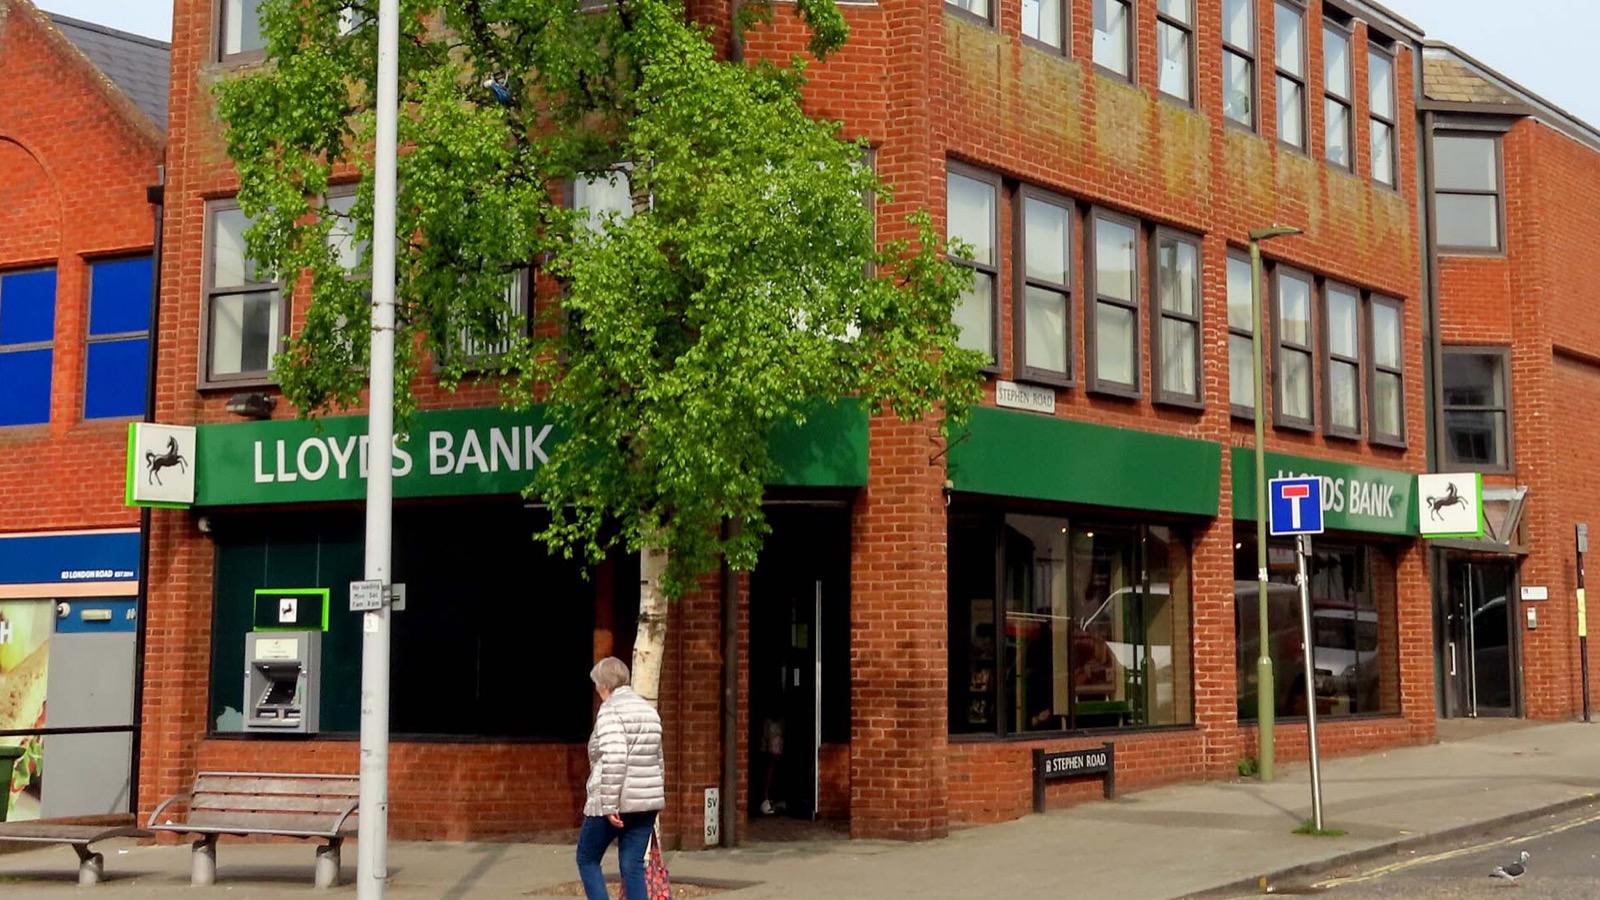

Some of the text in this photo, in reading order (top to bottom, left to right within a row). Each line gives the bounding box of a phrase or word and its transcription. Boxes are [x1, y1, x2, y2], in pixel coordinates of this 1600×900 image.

[998, 388, 1053, 407] STEPHEN ROAD
[429, 424, 554, 475] BANK
[1350, 479, 1394, 518] BANK
[69, 570, 95, 579] LONDON
[95, 569, 113, 578] ROAD
[1052, 753, 1107, 772] STEPHEN ROAD
[707, 797, 718, 808] SV
[706, 825, 717, 837] SV
